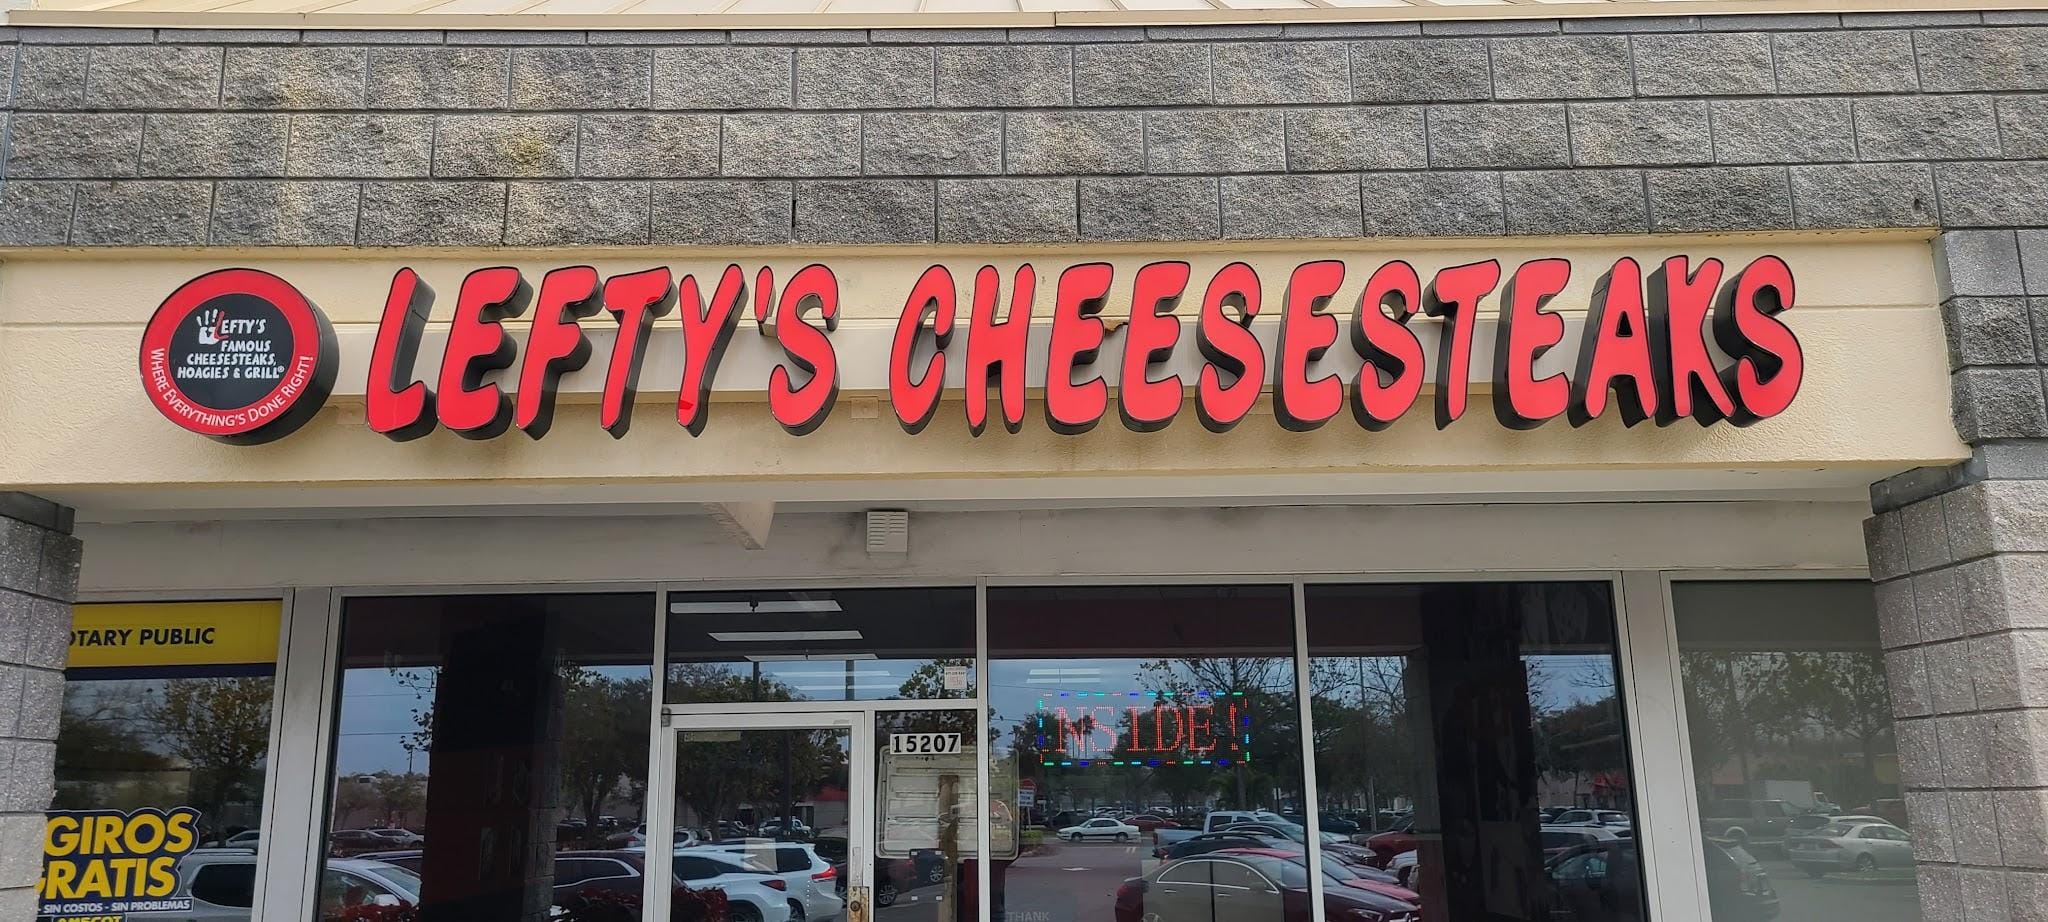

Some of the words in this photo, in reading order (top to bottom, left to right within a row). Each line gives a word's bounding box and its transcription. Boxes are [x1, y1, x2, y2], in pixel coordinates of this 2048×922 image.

[221, 340, 271, 352] FAMOUS
[365, 263, 840, 439] LEFTY'S
[888, 254, 1804, 433] CHEESESTEAKS
[187, 353, 276, 366] CHEESESTEAKS,
[177, 367, 229, 379] HOAGIES
[233, 367, 241, 379] &
[151, 348, 170, 392] WHERE
[163, 389, 246, 427] EVERYTHING'S
[248, 394, 286, 422] DONE
[281, 356, 313, 398] RIGHT!
[140, 628, 216, 645] PUBLIC
[1042, 704, 1240, 752] NSIDE!
[893, 734, 960, 753] 15207
[44, 812, 194, 857] GIROS
[43, 903, 61, 914] SIN
[63, 902, 103, 913] COSTOS
[111, 901, 130, 912] SIN
[130, 900, 190, 911] PROBLEMAS
[1005, 911, 1049, 921] THANK
